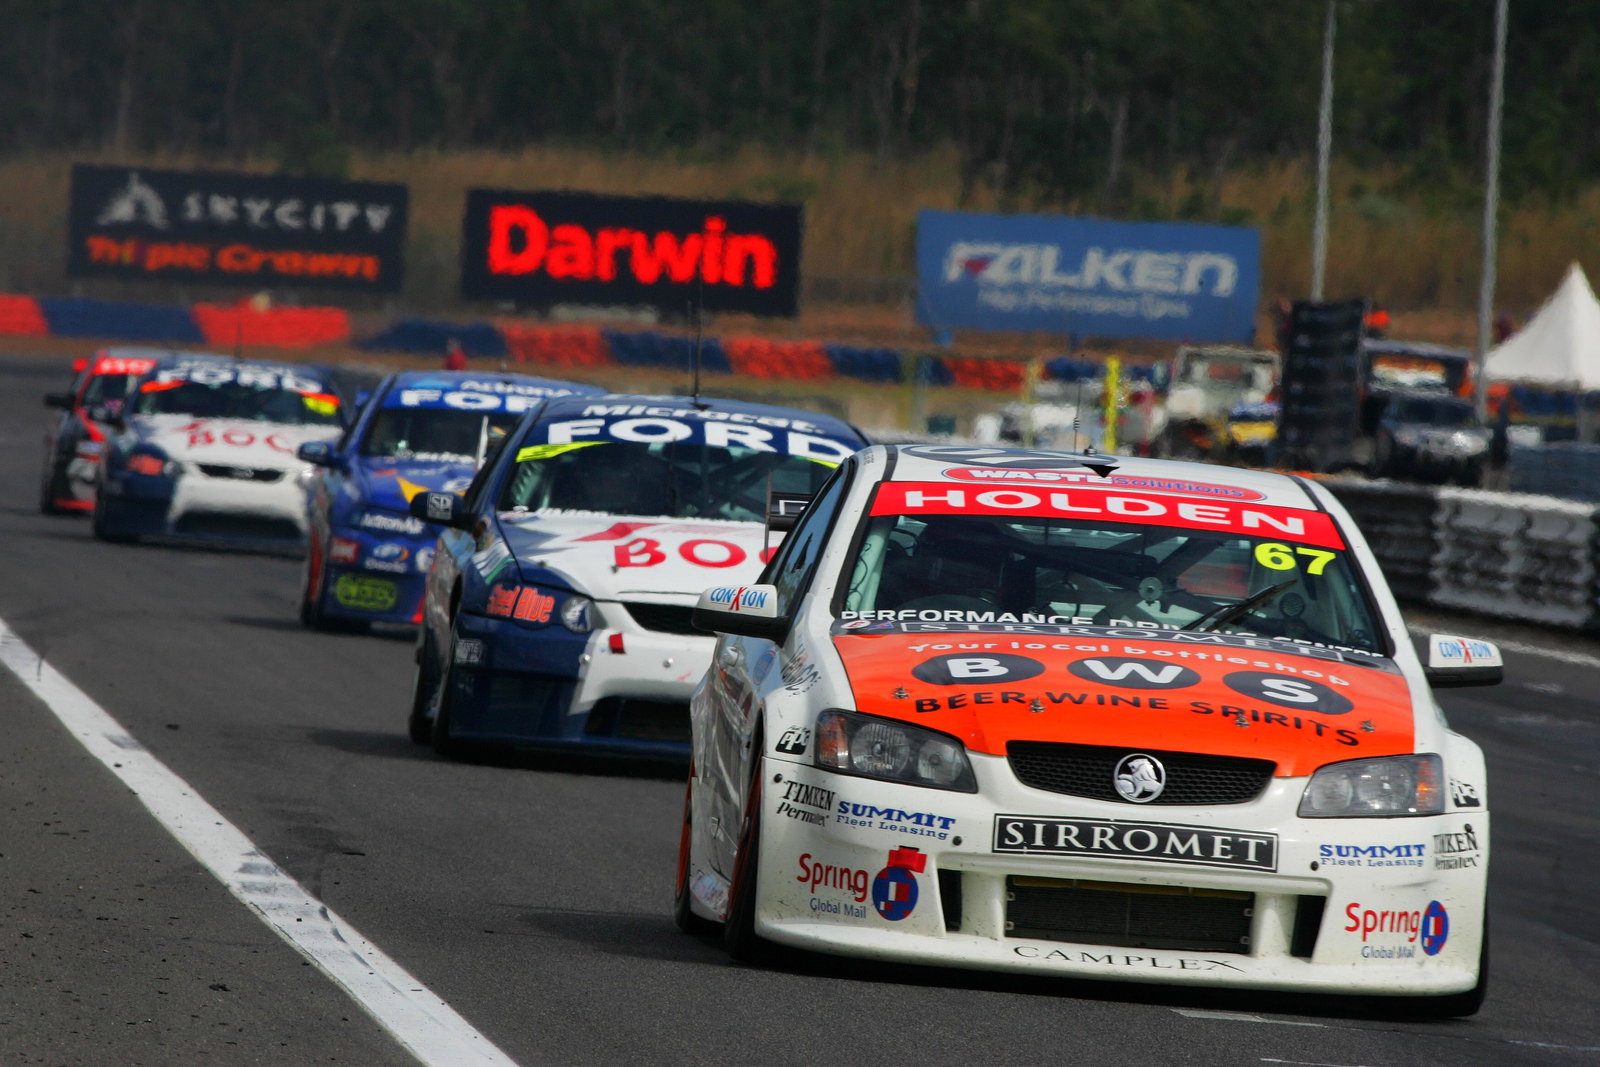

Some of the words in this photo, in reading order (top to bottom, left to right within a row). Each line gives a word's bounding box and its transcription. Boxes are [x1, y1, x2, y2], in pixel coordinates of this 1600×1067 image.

[184, 193, 391, 232] SKYCITY
[216, 243, 381, 281] Crown
[488, 204, 778, 289] Darwin
[547, 417, 856, 465] FORD
[904, 489, 1306, 536] HOLDEN
[1254, 542, 1337, 576] 67
[512, 586, 556, 623] Blue
[946, 658, 1009, 678] B
[1083, 659, 1184, 684] W
[1260, 678, 1320, 704] S
[1010, 641, 1111, 653] local
[1123, 645, 1351, 687] bottleshop
[914, 691, 1027, 713] BEER
[1044, 691, 1169, 710] WINE
[1189, 701, 1360, 747] SPIRITS
[782, 780, 837, 812] TIMKEN
[837, 800, 956, 831] SUMMIT
[836, 814, 873, 828] Fleet
[879, 821, 949, 841] Leasing
[1003, 821, 1268, 863] SIRROMET
[1319, 843, 1426, 858] SUMMIT
[796, 853, 869, 903] Spring
[809, 897, 841, 915] Global
[843, 903, 867, 919] Mail
[1344, 902, 1421, 943] Spring
[1013, 945, 1247, 974] CAMPLEX
